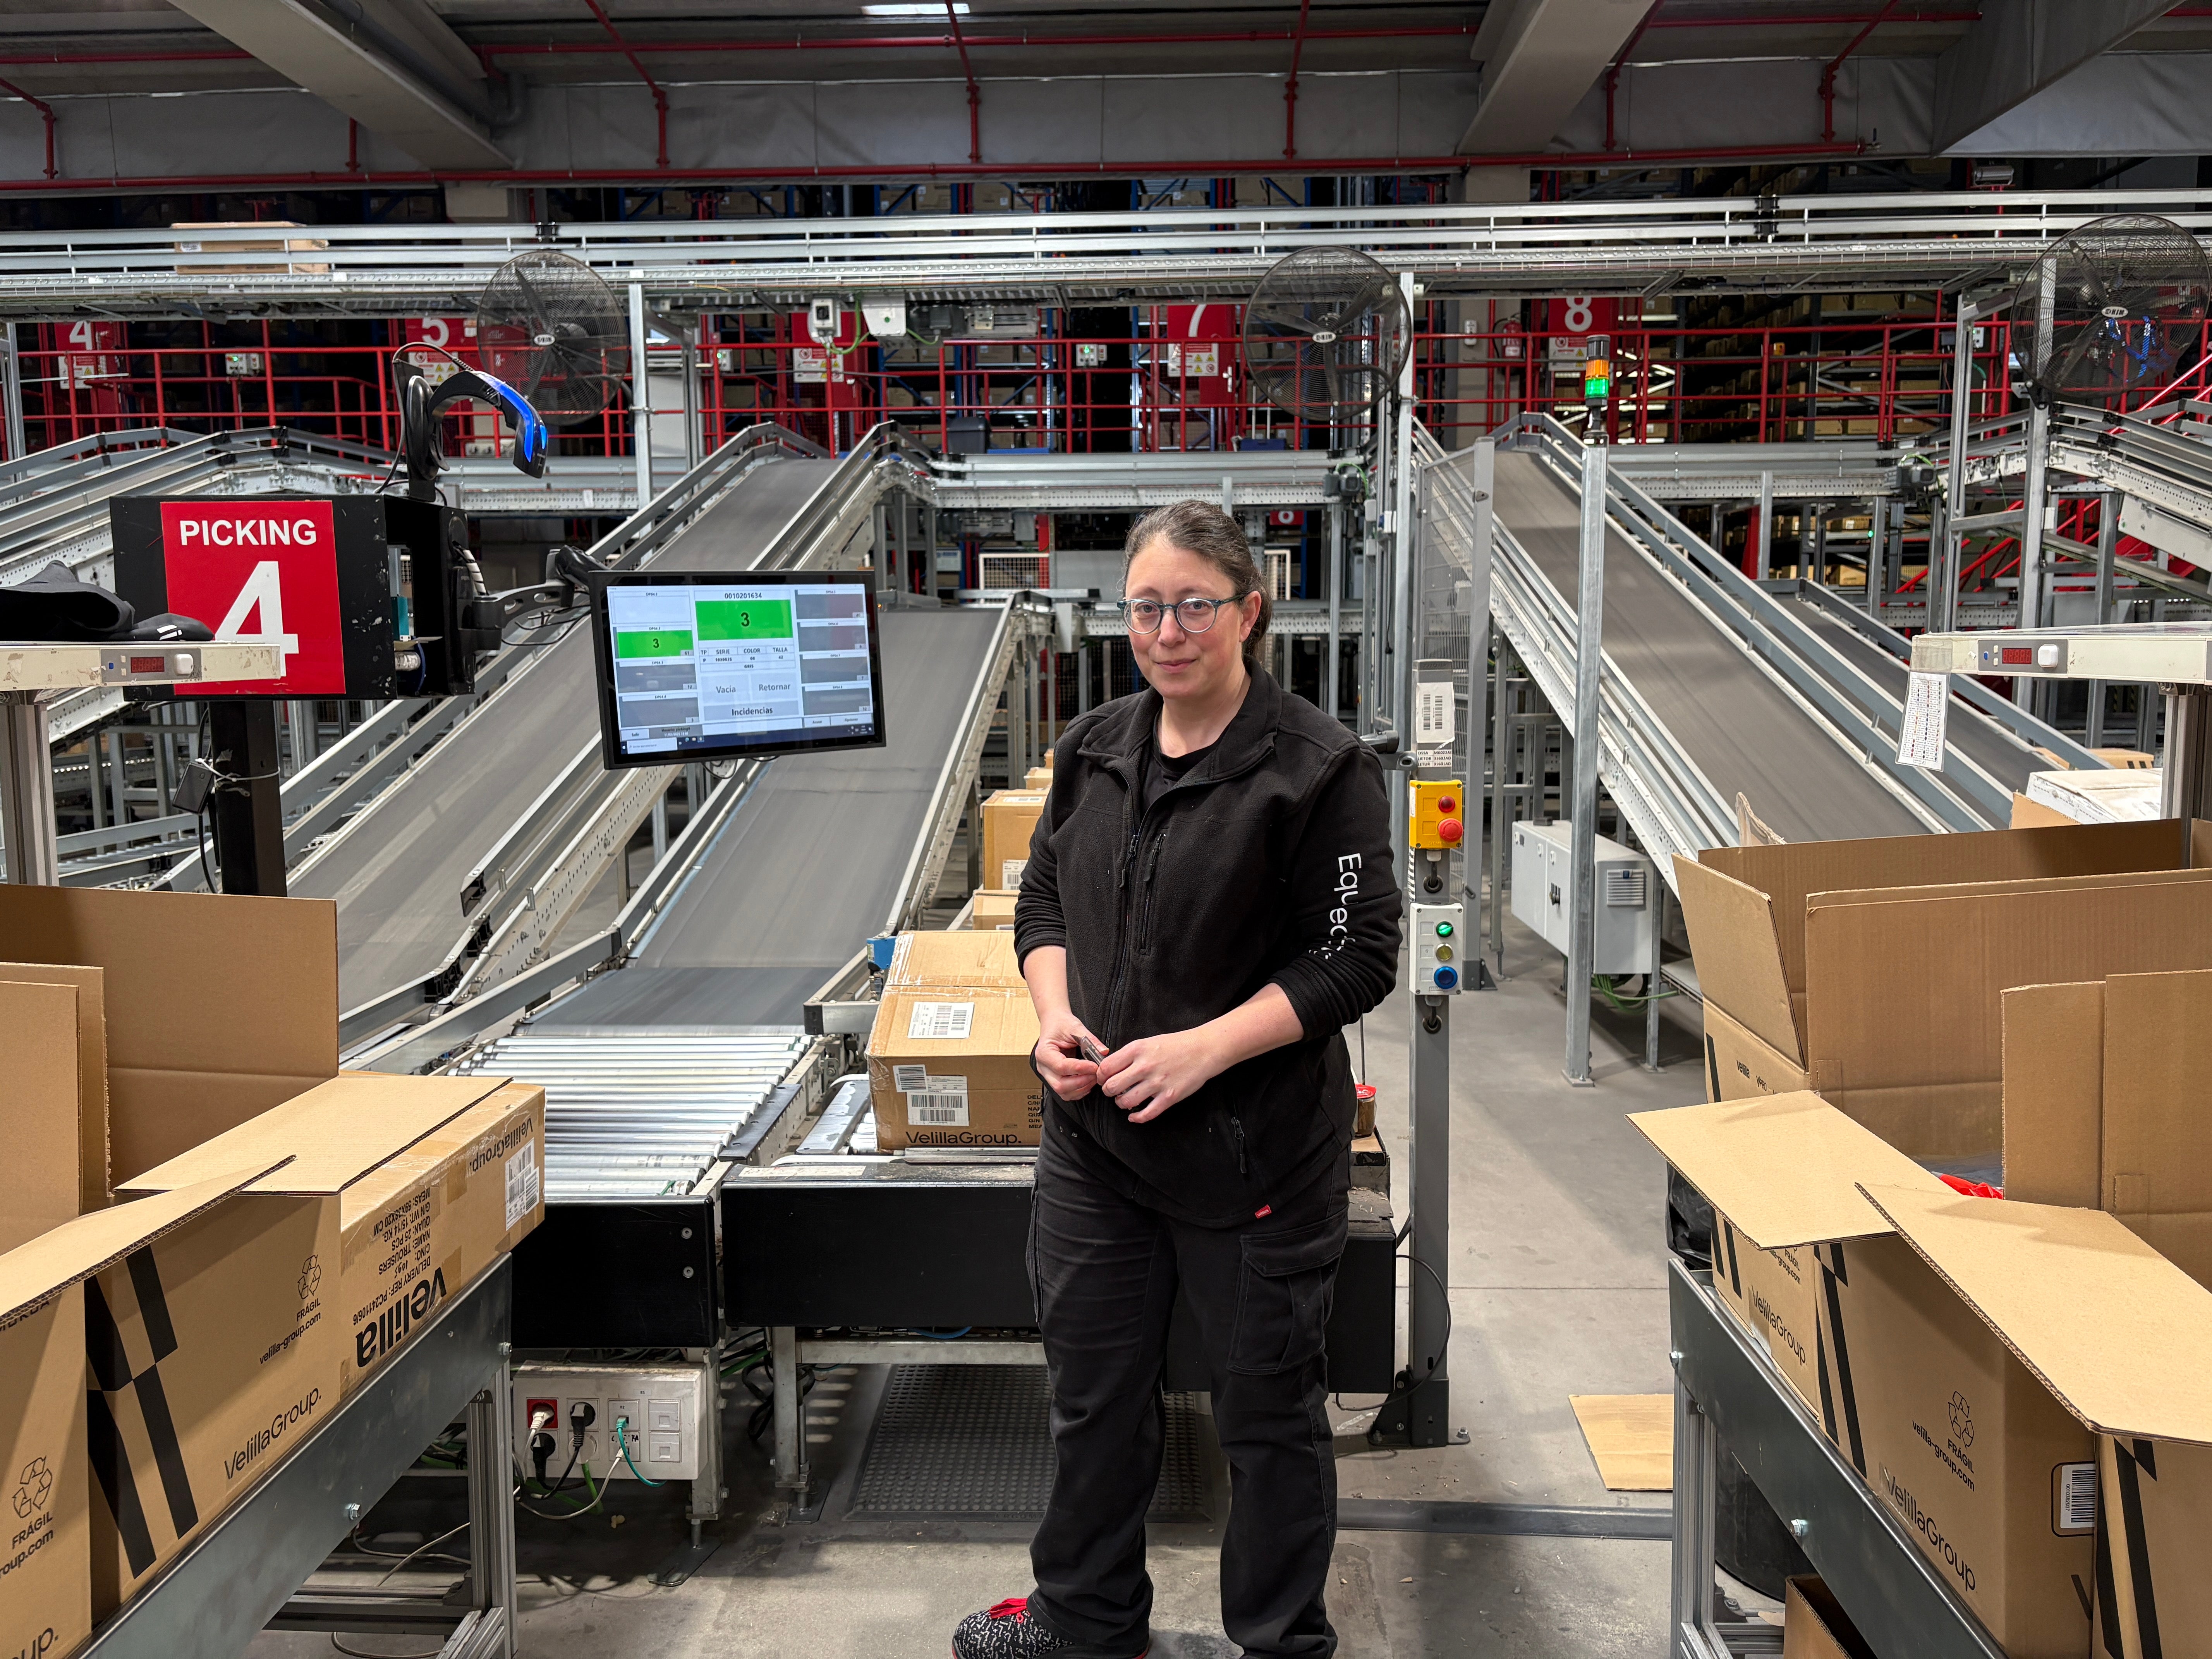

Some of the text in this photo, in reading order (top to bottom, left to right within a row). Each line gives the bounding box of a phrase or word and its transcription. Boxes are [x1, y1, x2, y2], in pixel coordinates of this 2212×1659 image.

[1564, 297, 1592, 332] 8
[69, 320, 93, 350] 4
[422, 318, 449, 347] 5
[180, 519, 317, 546] PICKING
[215, 561, 299, 677] 4
[740, 612, 750, 627] 3
[653, 638, 659, 648] 3
[716, 685, 736, 694] Vacía
[732, 706, 773, 716] Incidencias
[469, 1118, 533, 1172] VelillaGroup.
[906, 1132, 1022, 1146] VelillaGroup.
[413, 1187, 430, 1206] MEAS:
[374, 1220, 383, 1236] CM
[382, 1201, 430, 1242] G/N WT: 15/14 KG.
[392, 1216, 430, 1251] QUAN: 25 PCS
[379, 1228, 430, 1275] NAME: TROUSERS
[415, 1243, 430, 1261] C/NO:
[353, 1255, 431, 1326] DELIVERY REF: PC241106/6
[297, 1298, 321, 1322] FRÁGIL
[356, 1266, 447, 1368] velilla
[260, 1312, 321, 1364] velilla-group.com
[224, 1388, 322, 1479] VelillaGroup.
[1912, 1420, 1975, 1492] velilla-group.com
[1948, 1438, 1974, 1474] FRÁGIL
[12, 1511, 53, 1549] FRÁGIL
